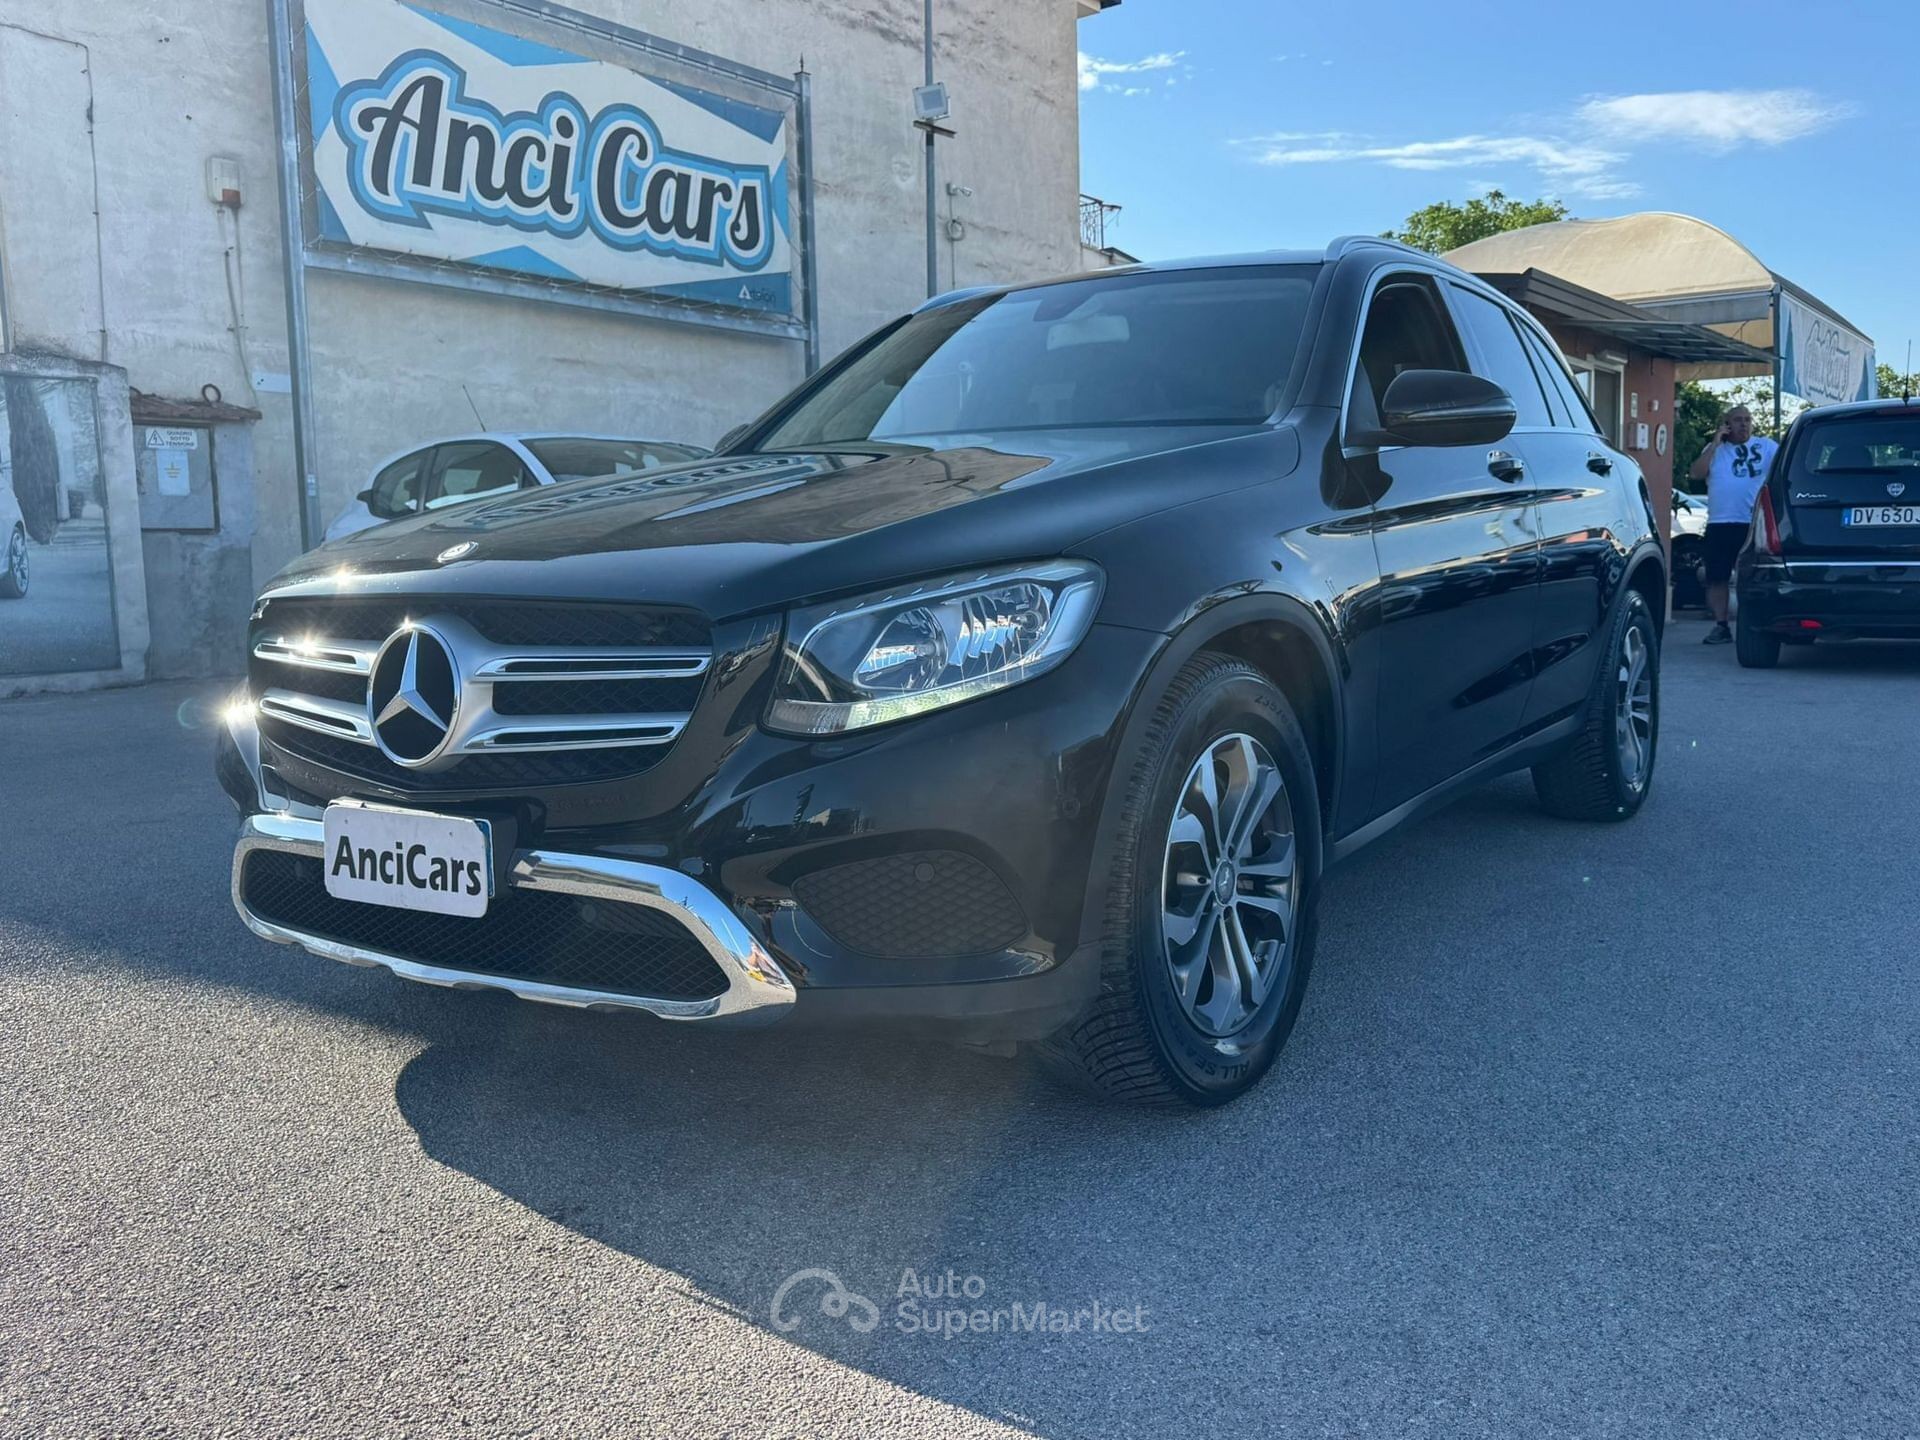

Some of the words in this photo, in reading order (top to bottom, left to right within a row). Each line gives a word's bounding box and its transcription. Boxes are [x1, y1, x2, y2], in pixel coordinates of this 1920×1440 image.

[357, 74, 574, 216] Anci
[596, 126, 761, 251] Cars
[1853, 509, 1875, 524] DV
[331, 835, 482, 896] AnciCars
[1220, 1059, 1250, 1080] ALL
